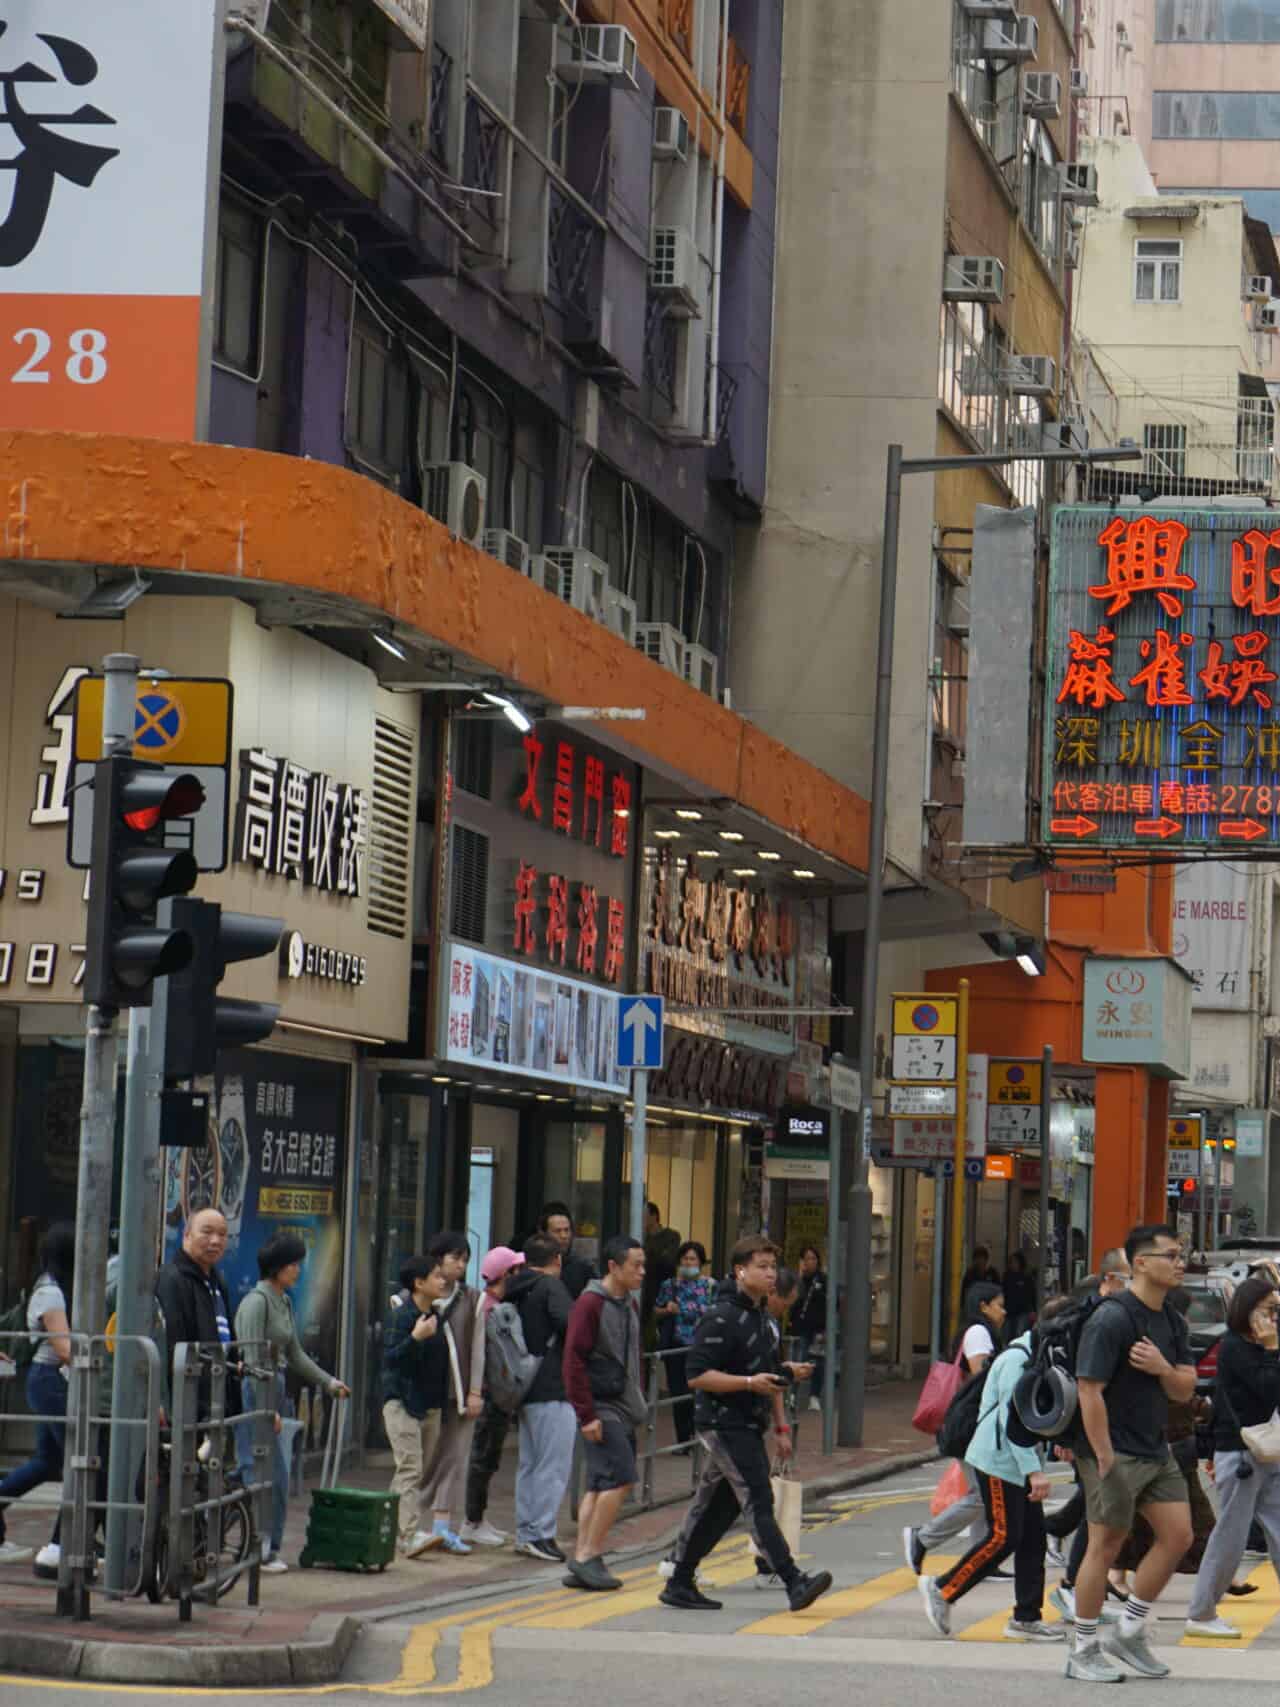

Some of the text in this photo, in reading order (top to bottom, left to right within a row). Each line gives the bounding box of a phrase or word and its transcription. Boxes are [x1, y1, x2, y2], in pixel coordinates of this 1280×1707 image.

[0, 869, 43, 900] S
[1190, 902, 1248, 920] MARBLE
[934, 1039, 945, 1053] 7
[933, 1062, 944, 1076] 7
[1022, 1107, 1032, 1121] 7
[789, 1118, 823, 1130] Roca
[1022, 1128, 1038, 1140] 12
